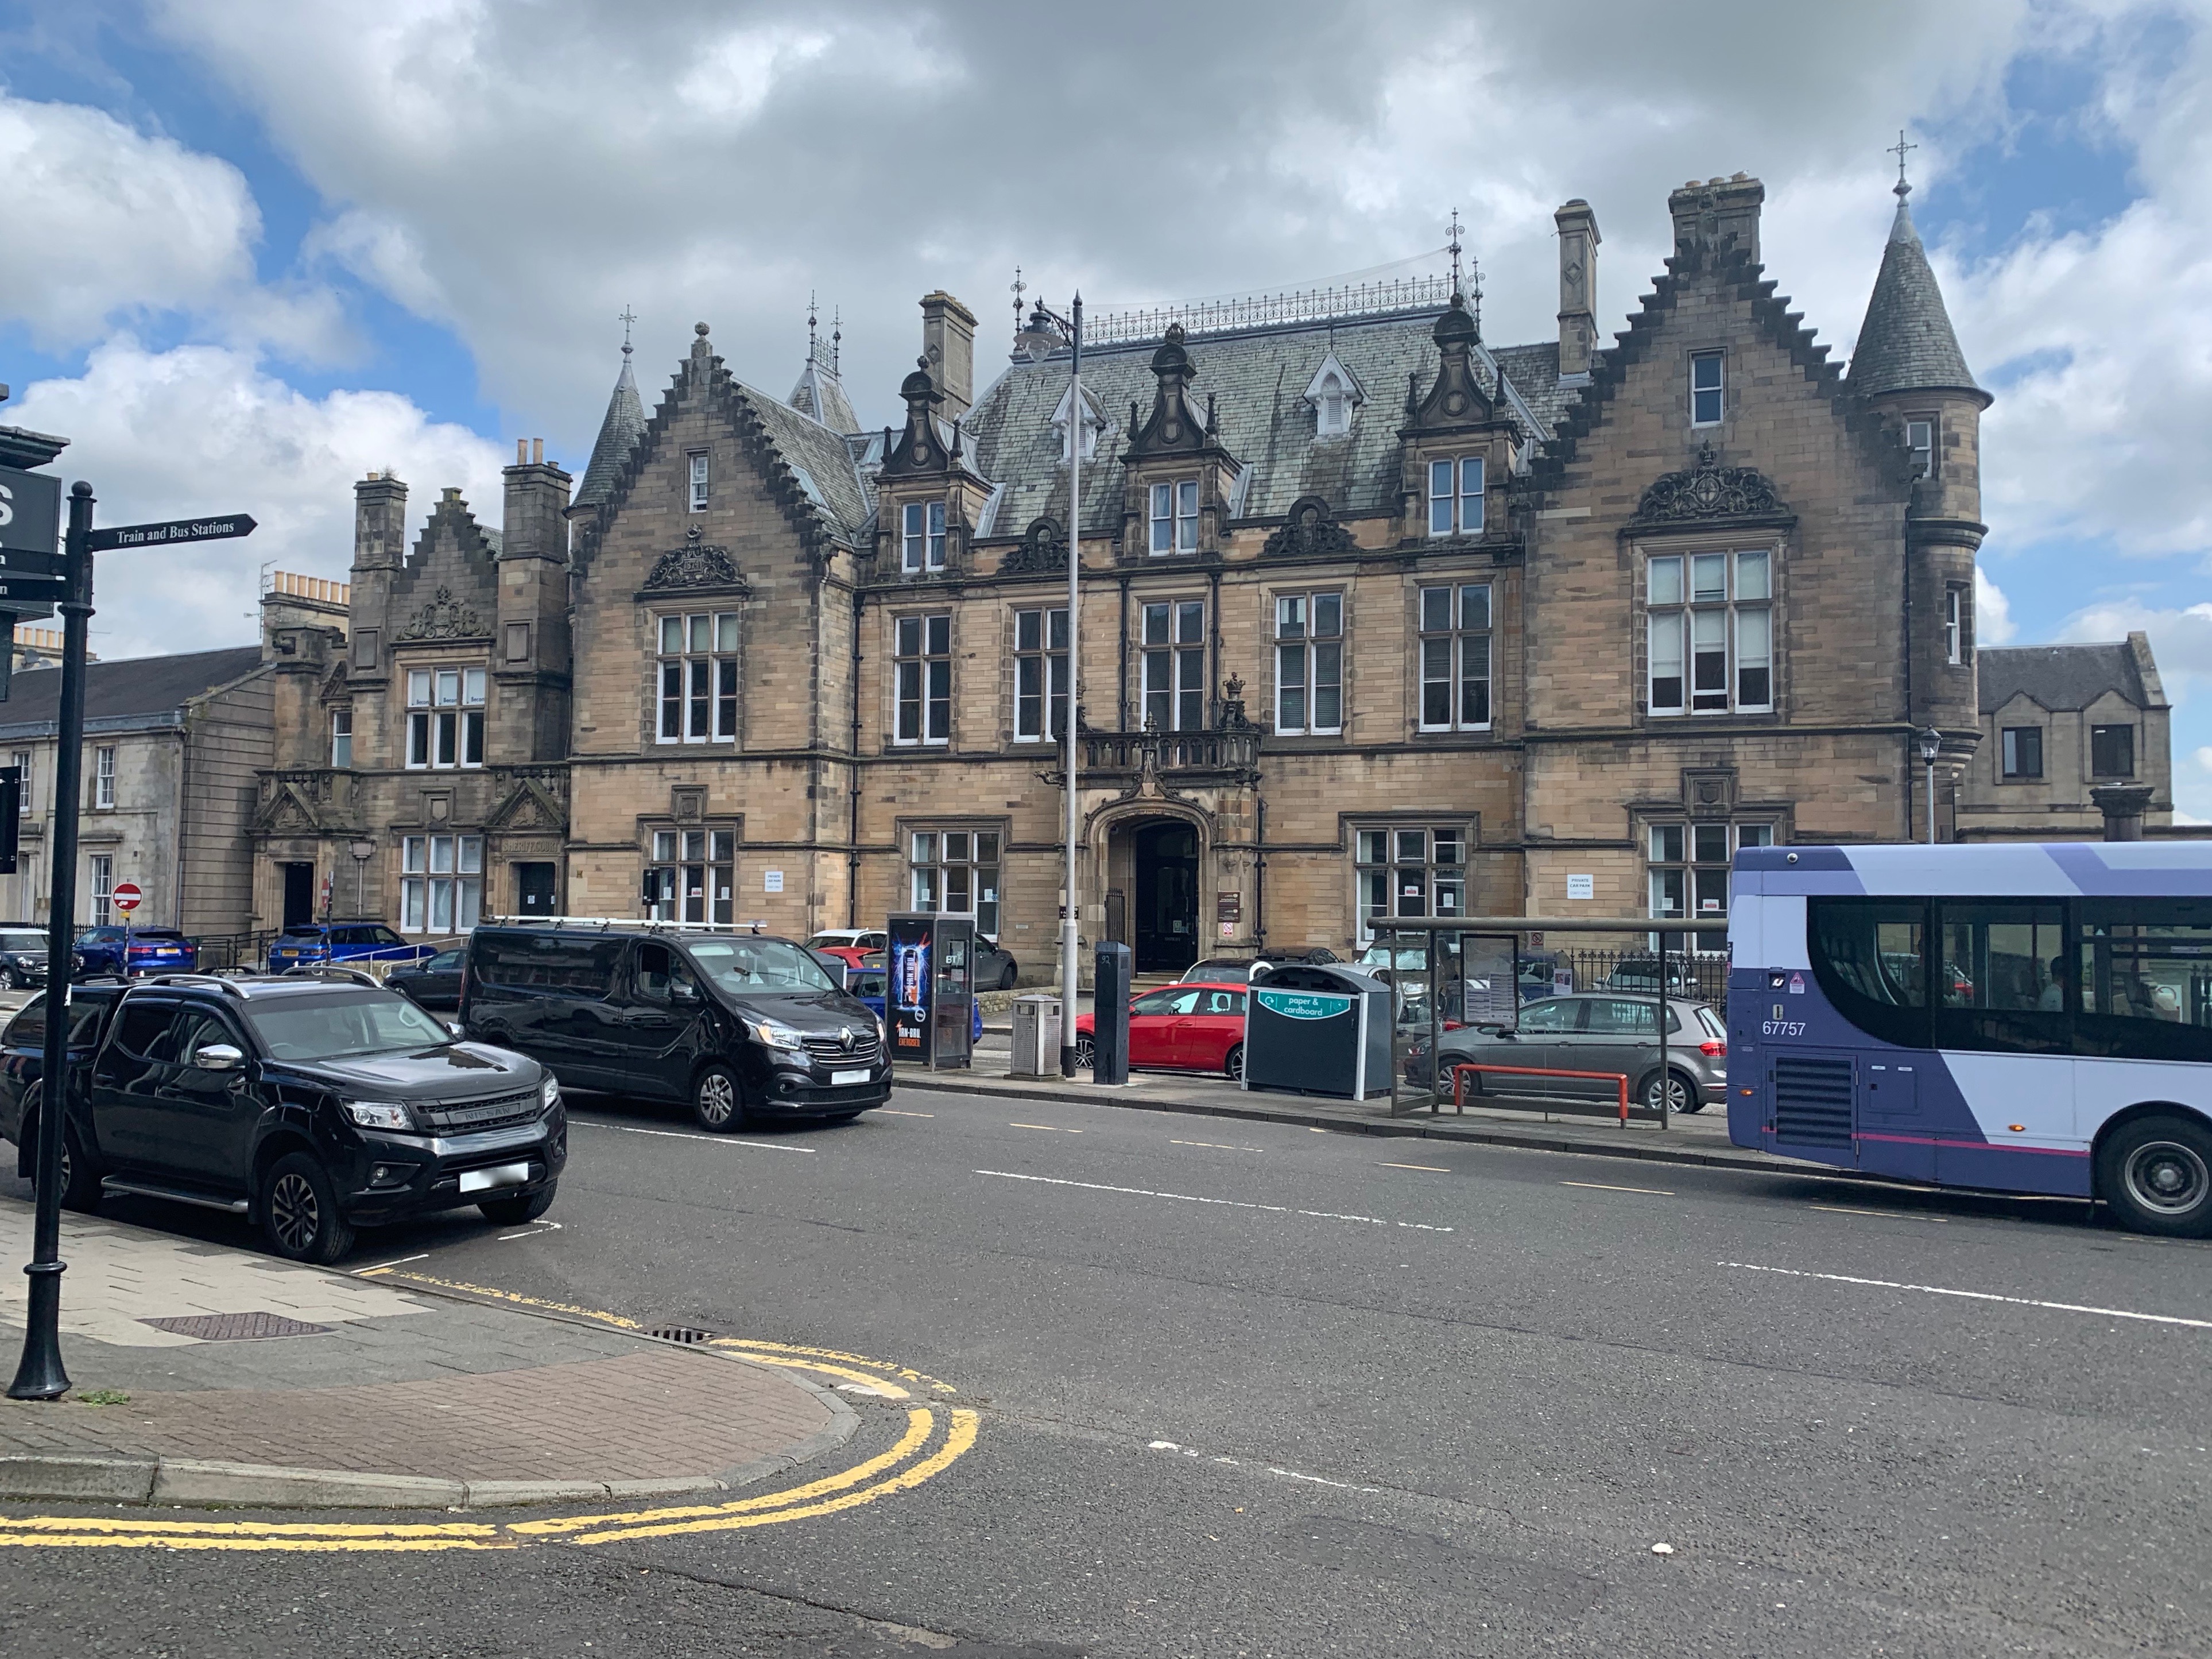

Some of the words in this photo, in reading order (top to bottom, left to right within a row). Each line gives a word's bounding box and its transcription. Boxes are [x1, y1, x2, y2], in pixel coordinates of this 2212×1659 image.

[117, 529, 144, 544] Train
[147, 527, 166, 541] and
[169, 525, 189, 539] Bus
[191, 521, 234, 536] Stations
[946, 955, 957, 964] BT
[1288, 997, 1311, 1006] paper
[1312, 997, 1319, 1006] &
[1284, 1006, 1323, 1016] cardboard
[1762, 1020, 1806, 1036] 67757
[466, 1107, 510, 1120] NISSAN
